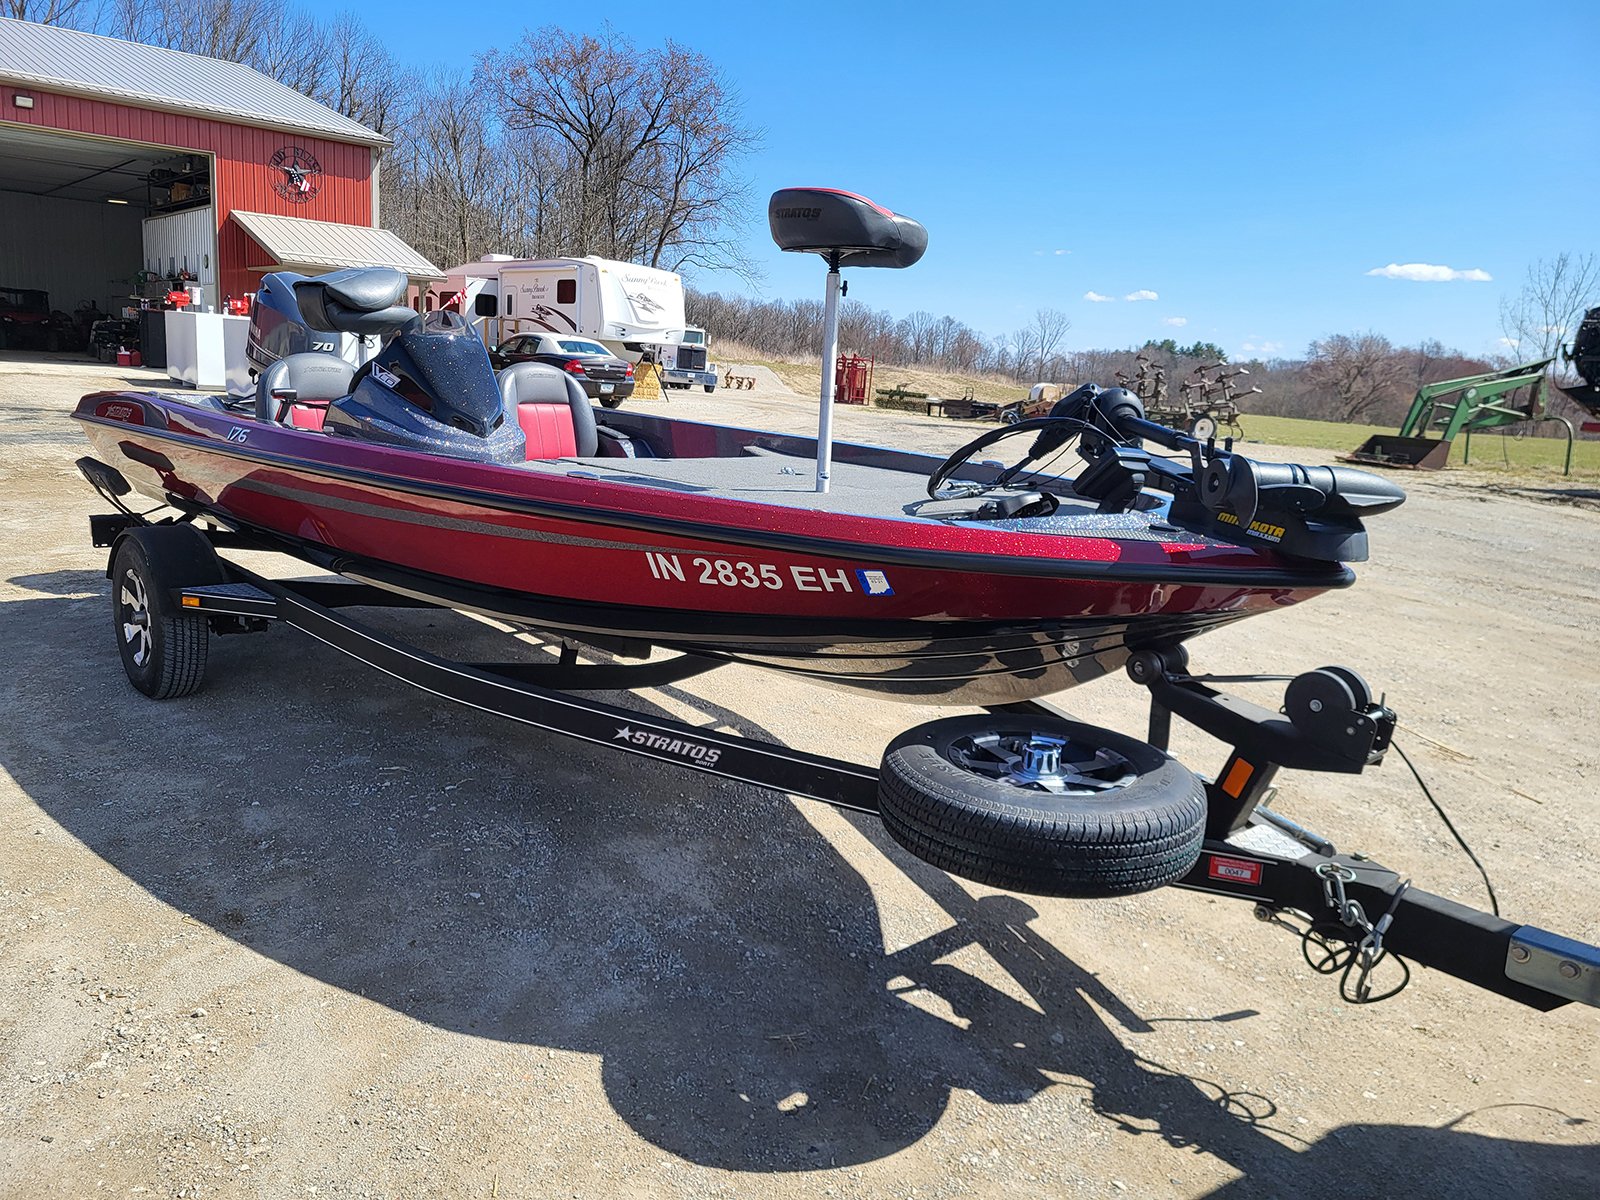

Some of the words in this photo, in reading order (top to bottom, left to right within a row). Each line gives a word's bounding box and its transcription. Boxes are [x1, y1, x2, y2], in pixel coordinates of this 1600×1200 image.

[775, 207, 822, 219] STRATOS
[312, 341, 335, 352] 70
[227, 426, 251, 443] 176
[1249, 520, 1286, 538] KOTA
[645, 552, 686, 582] IN
[692, 557, 784, 590] 2835
[789, 565, 853, 593] EH
[631, 730, 722, 763] STRATOS
[1224, 867, 1245, 877] 0047
